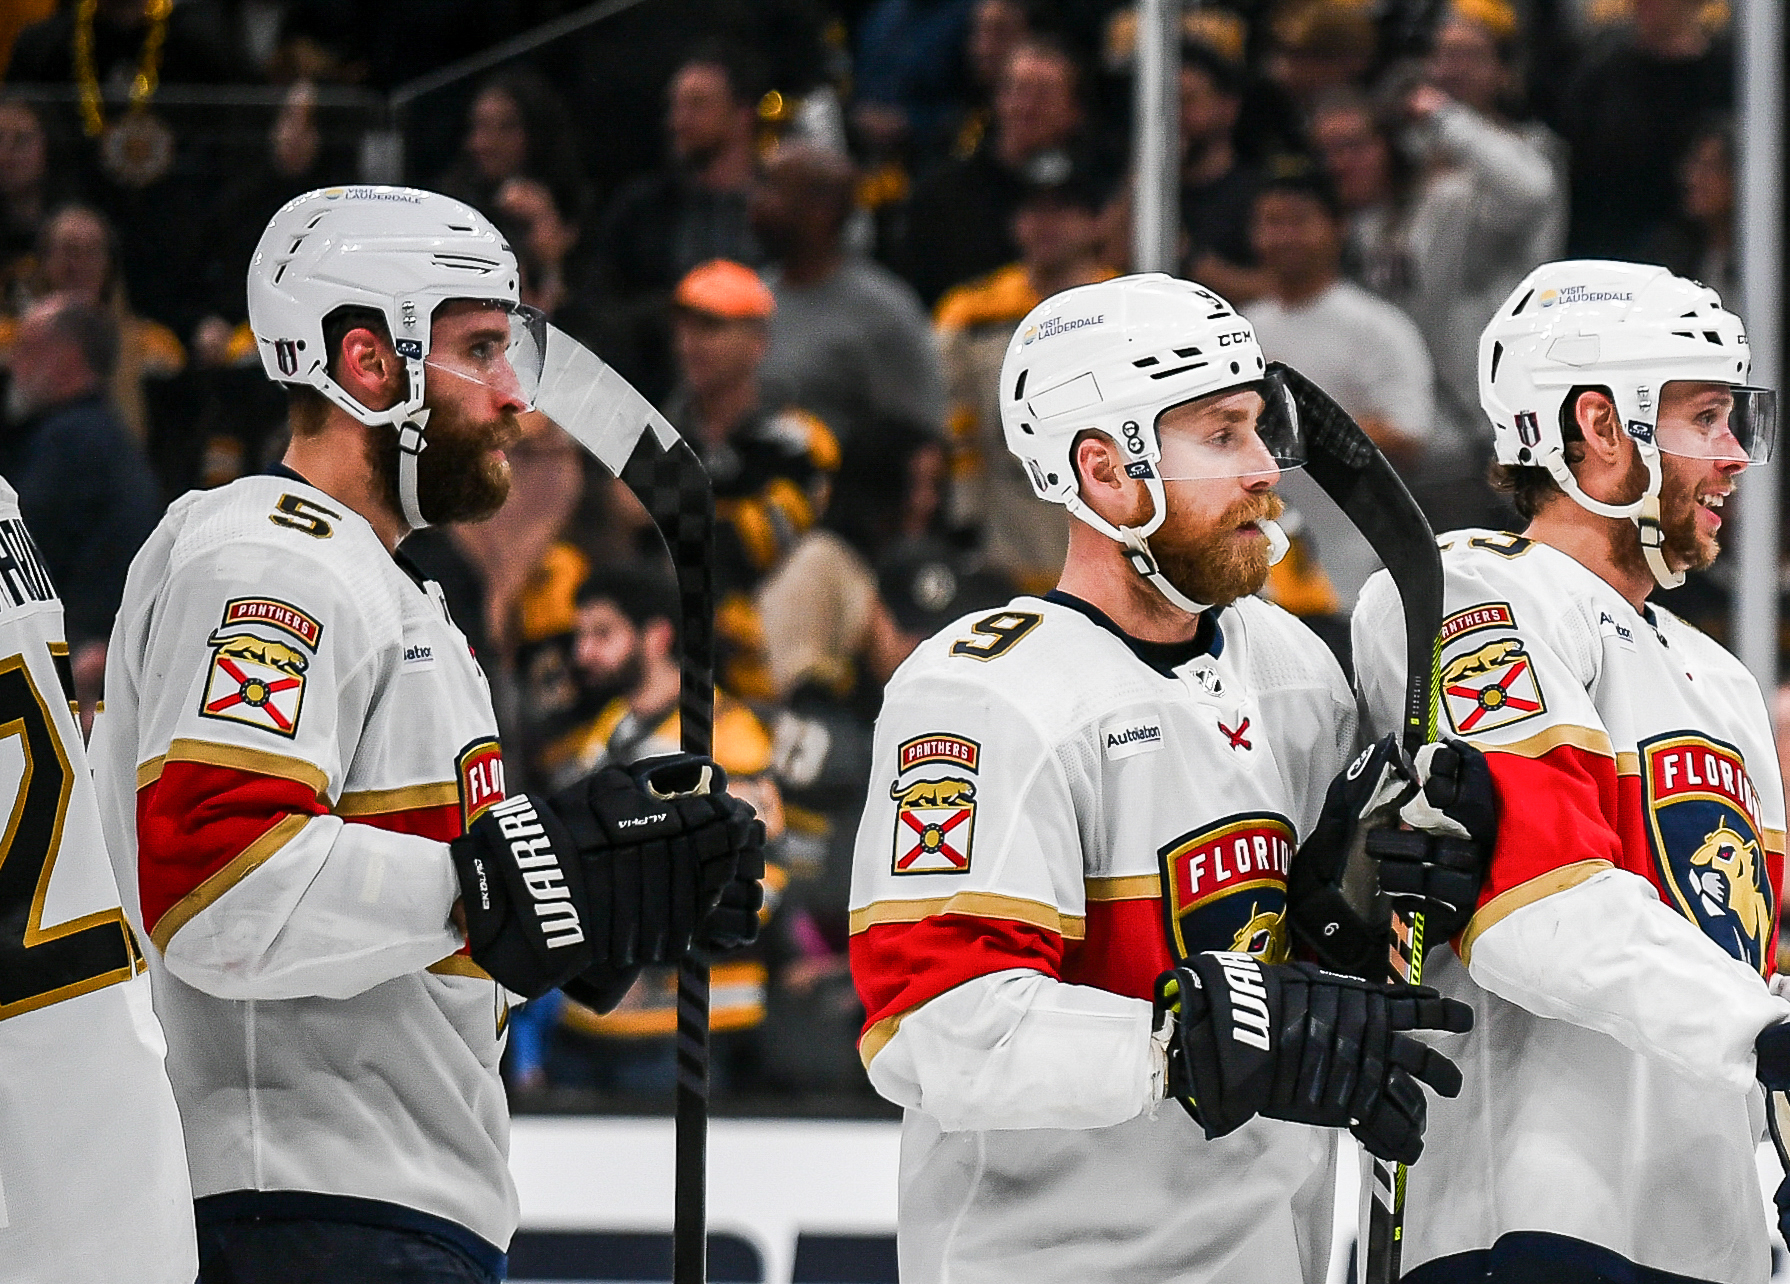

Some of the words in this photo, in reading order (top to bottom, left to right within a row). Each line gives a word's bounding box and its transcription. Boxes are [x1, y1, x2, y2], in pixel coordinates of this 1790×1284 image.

[1558, 292, 1632, 305] LAUDERDALE
[1560, 285, 1586, 295] VISIT
[1037, 314, 1104, 341] LAUDERDALE
[1038, 316, 1062, 330] VISIT
[1217, 331, 1252, 347] CCM
[268, 493, 342, 539] 5
[238, 603, 310, 635] PANTHERS
[1441, 608, 1501, 639] ANTHERS
[949, 611, 1044, 663] 9
[908, 740, 969, 761] PANTHERS
